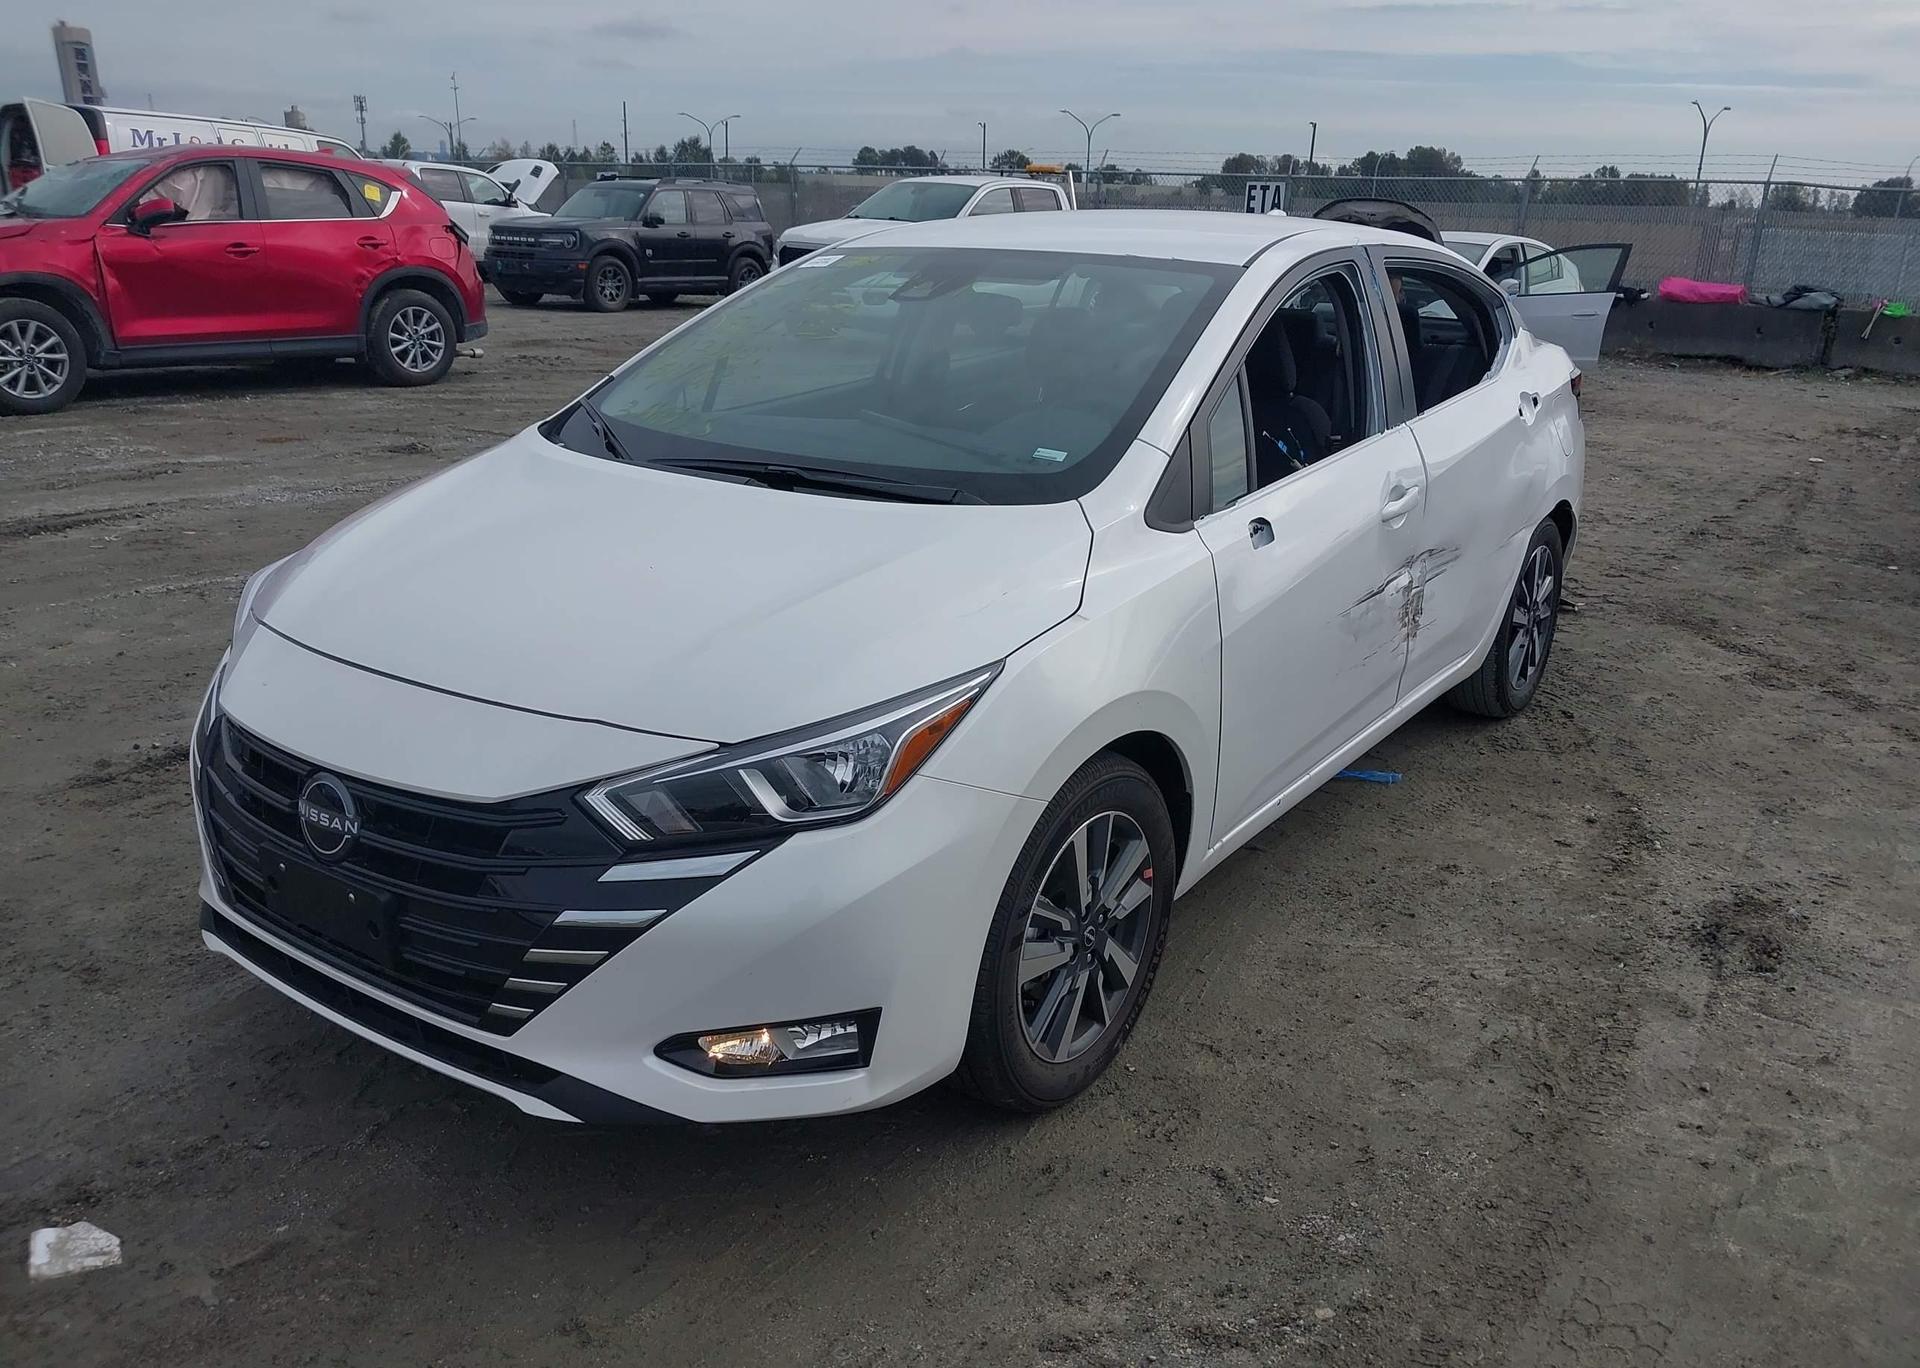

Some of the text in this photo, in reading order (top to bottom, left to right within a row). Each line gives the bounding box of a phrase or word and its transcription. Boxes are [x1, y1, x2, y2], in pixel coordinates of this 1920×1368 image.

[130, 128, 167, 148] Mr
[1246, 184, 1281, 213] ETA
[299, 799, 358, 834] NISSAN
